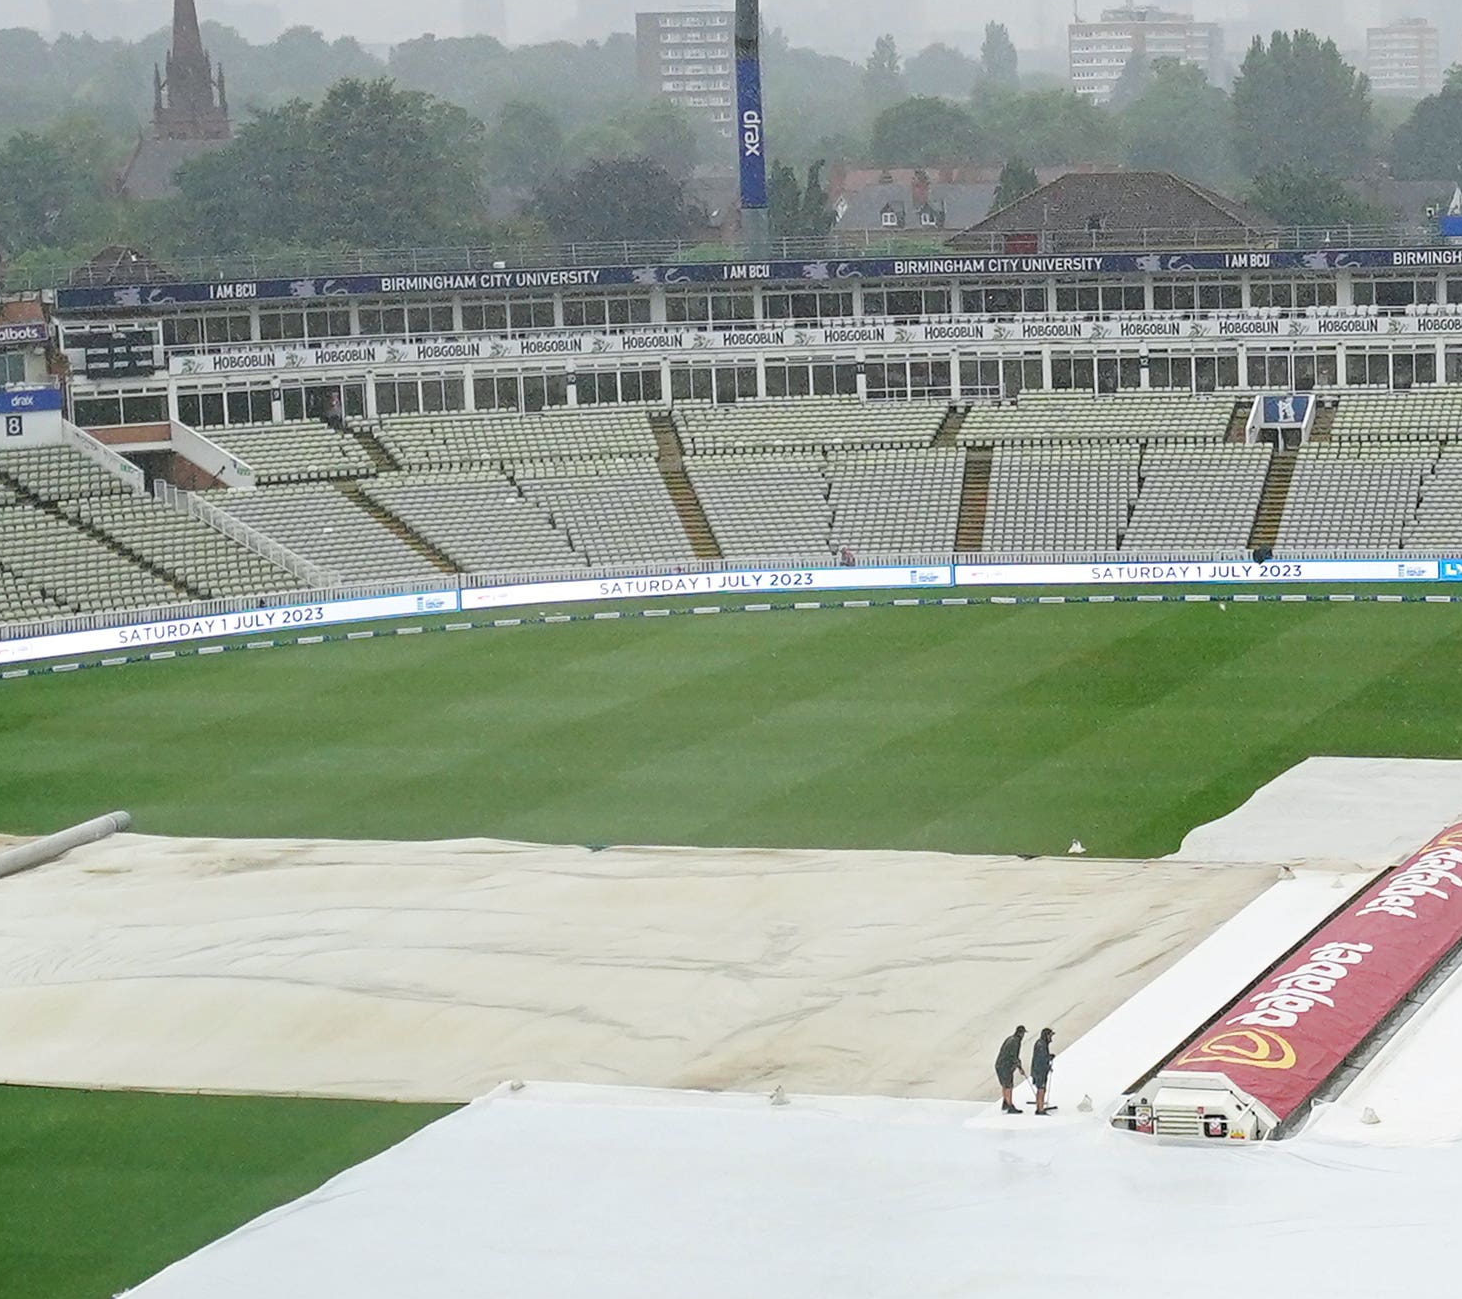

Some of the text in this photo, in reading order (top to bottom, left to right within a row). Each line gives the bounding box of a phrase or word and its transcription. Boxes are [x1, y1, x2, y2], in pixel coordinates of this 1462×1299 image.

[742, 109, 763, 157] drax
[895, 256, 1102, 274] BIRMINGHAM CITY UNIVERSITY
[1230, 255, 1248, 267] AM
[1250, 254, 1270, 267] BCU
[381, 269, 599, 291] BIRMINGHAM CITY UNIVERSITY
[216, 284, 234, 298] AM
[235, 283, 256, 298] BCU
[824, 327, 884, 342] HOBGOBLIN
[1023, 323, 1081, 337] HOBGOBLIN
[1219, 320, 1278, 334] HOBGOBLIN
[213, 352, 275, 370] HOBGOBLIN
[11, 395, 34, 408] drax
[8, 418, 21, 434] 8
[119, 619, 215, 644] SATURDAY
[234, 612, 276, 630] JULY
[282, 607, 324, 624] 2023
[1226, 940, 1373, 1027] dafabet
